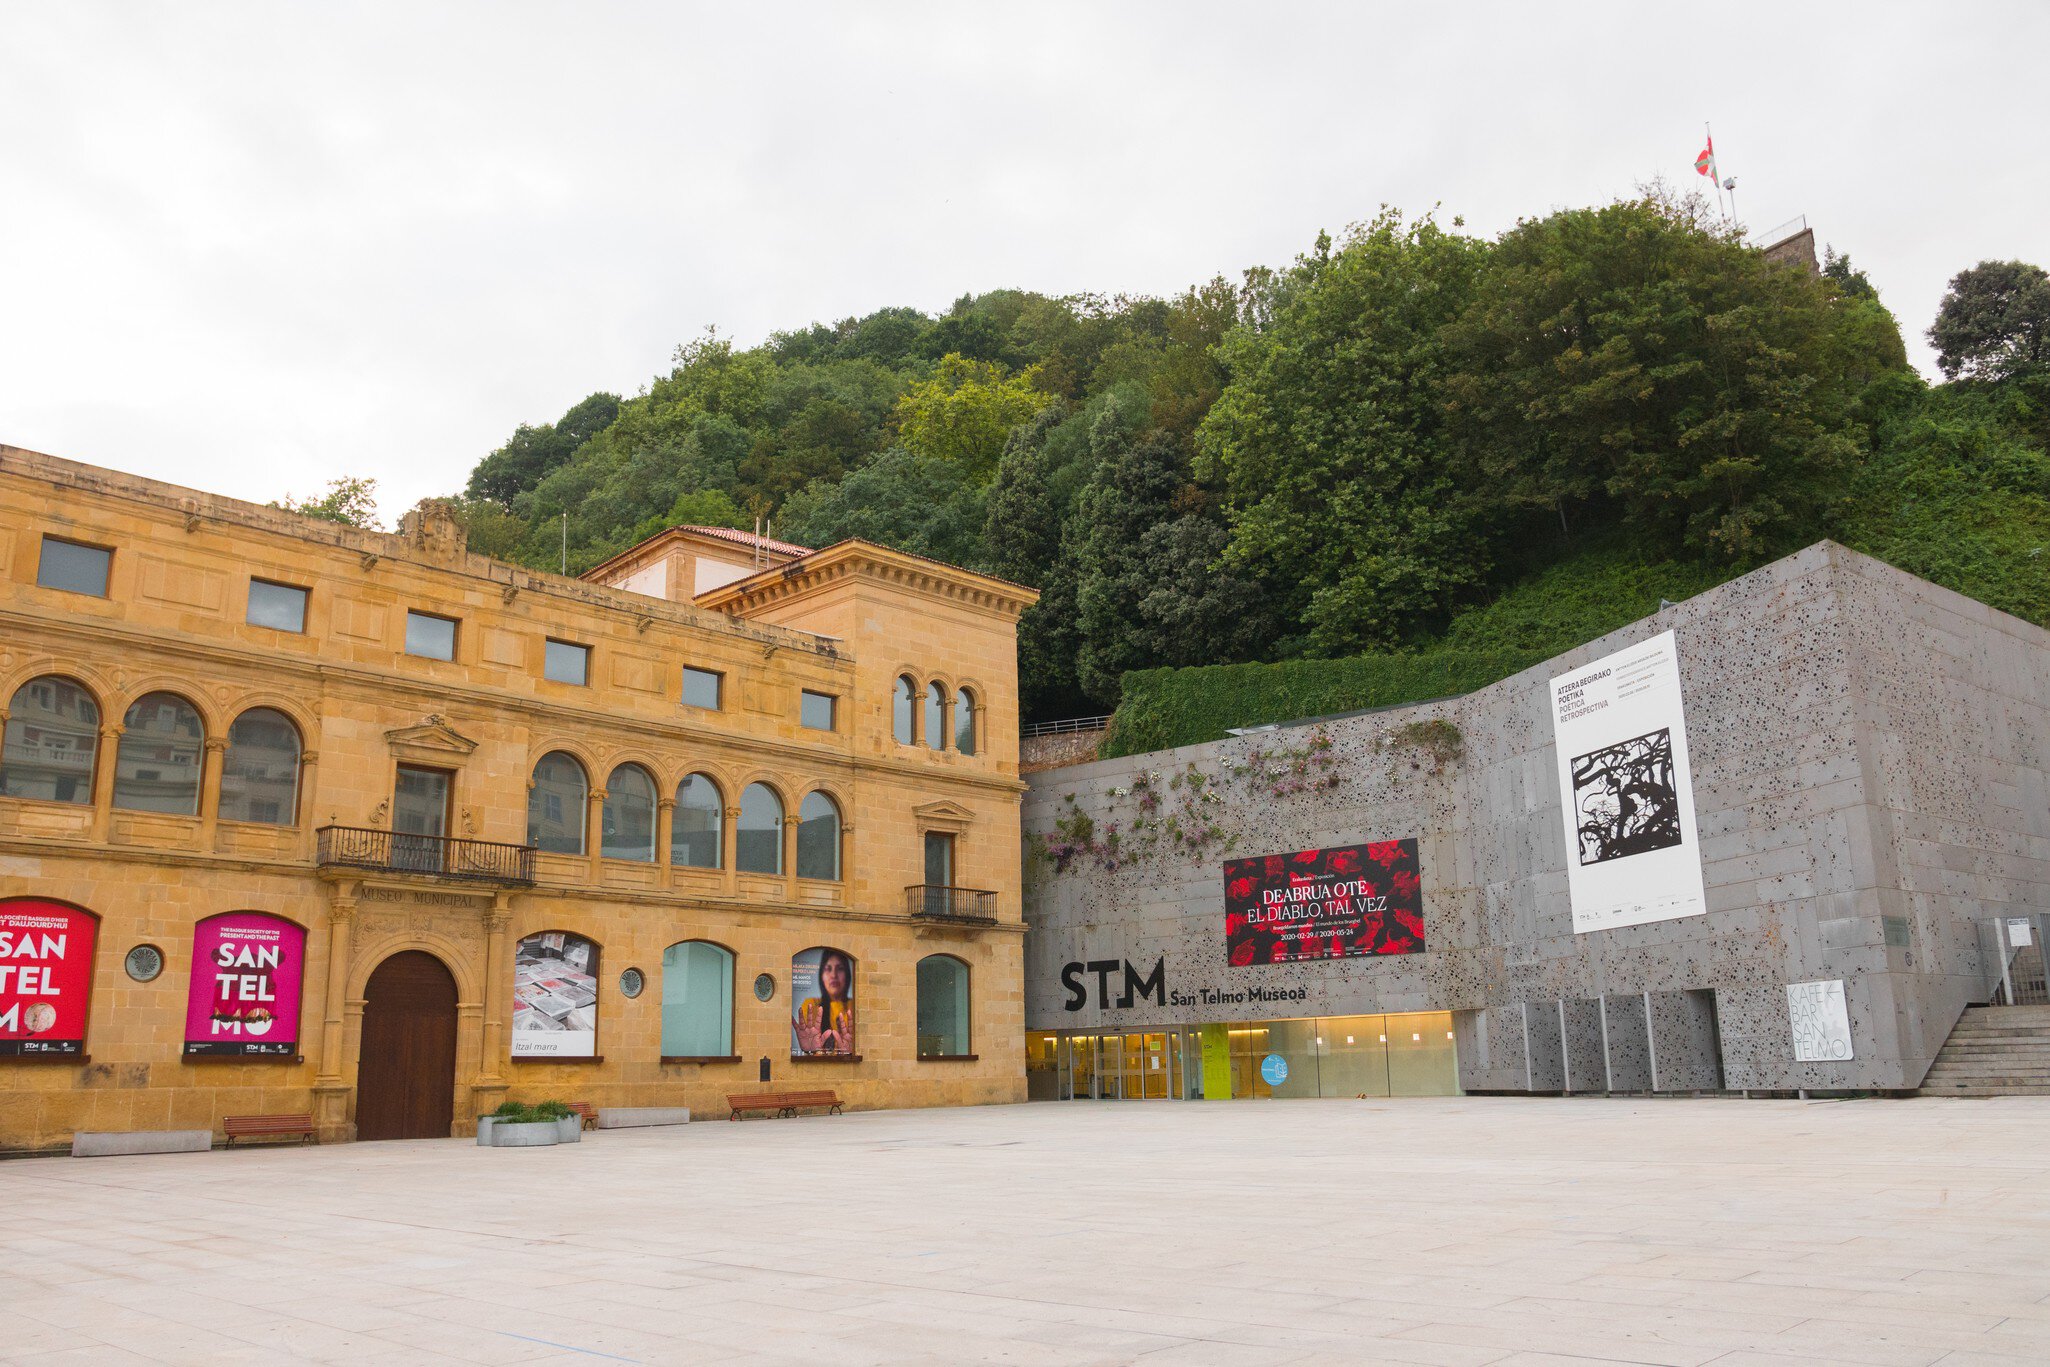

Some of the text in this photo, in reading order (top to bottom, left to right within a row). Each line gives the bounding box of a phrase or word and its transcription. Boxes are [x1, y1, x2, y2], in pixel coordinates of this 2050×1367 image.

[1557, 681, 1580, 695] ATZERA
[1579, 668, 1612, 687] BEGIRAKO
[1558, 689, 1584, 705] POETIKA
[1560, 699, 1609, 723] RETROSPECTIVA
[360, 888, 477, 908] MUSEO MUNICIPAL
[1262, 880, 1368, 905] DEABRUA OTE
[1247, 896, 1387, 923] EL DIABLO, TAL VEZ
[0, 931, 67, 960] SAN
[1280, 931, 1314, 941] 2020-02-29
[1319, 928, 1354, 938] 2020-05-24
[217, 942, 279, 969] SAN
[0, 965, 60, 995] TEL
[215, 973, 275, 1002] TEL
[1061, 955, 1166, 1012] STM
[1170, 986, 1306, 1006] San Telmo Museoa
[1788, 984, 1823, 1004] KAFE
[1791, 1003, 1819, 1023] BAR
[1793, 1021, 1826, 1041] SAN
[515, 1043, 533, 1051] Itzal
[1795, 1039, 1847, 1059] TELMO
